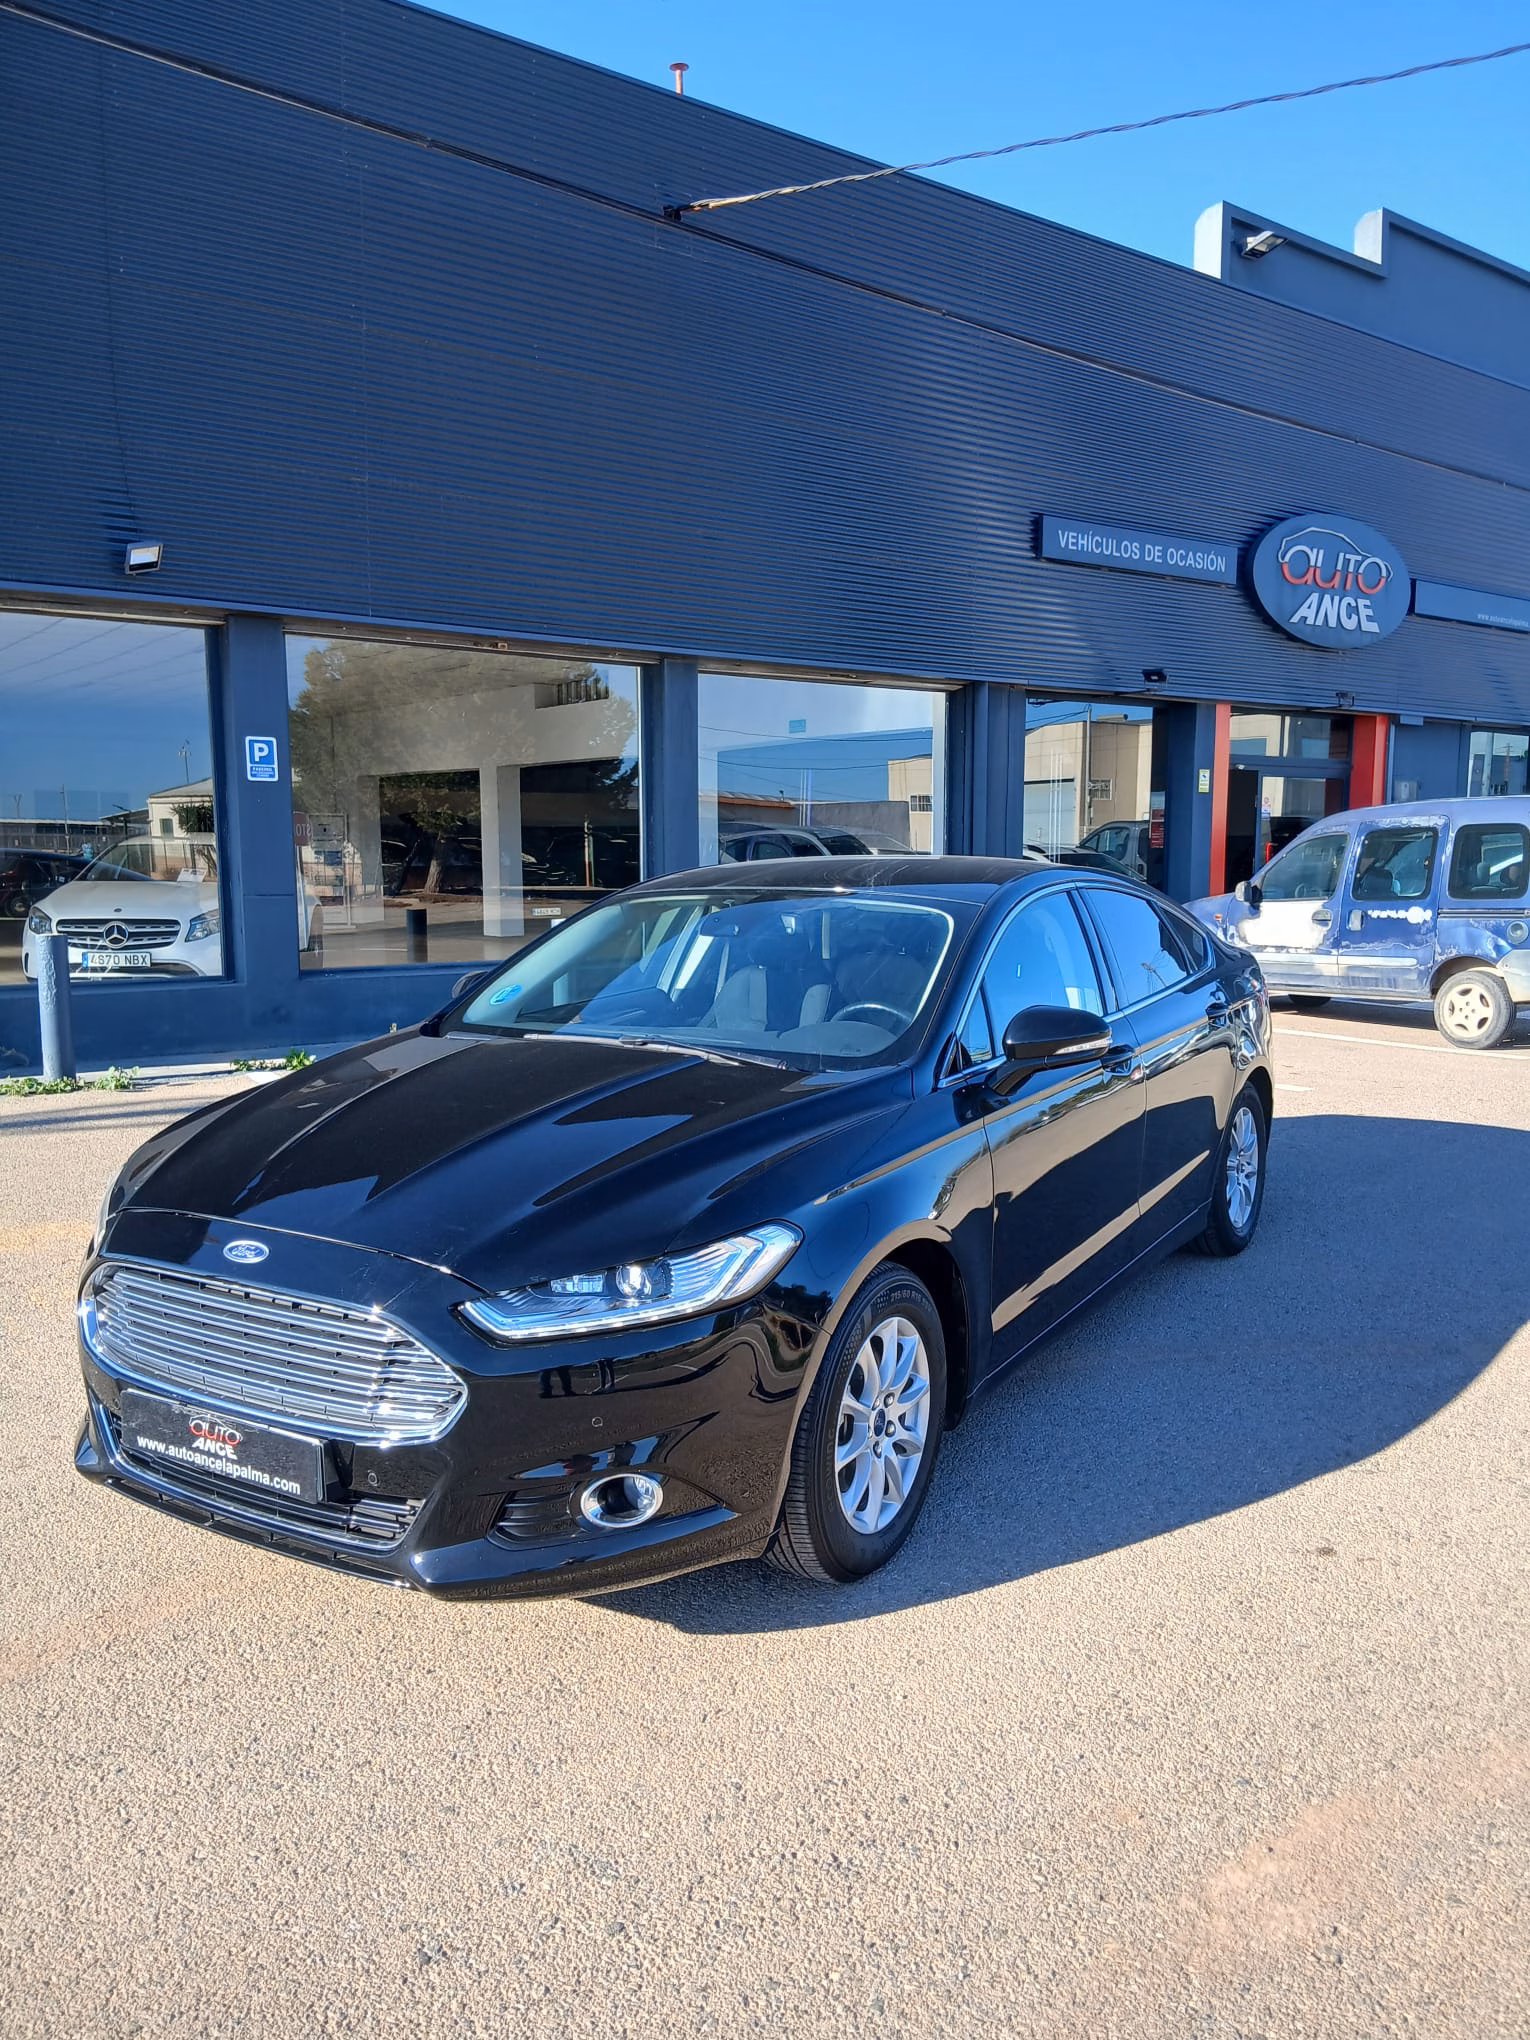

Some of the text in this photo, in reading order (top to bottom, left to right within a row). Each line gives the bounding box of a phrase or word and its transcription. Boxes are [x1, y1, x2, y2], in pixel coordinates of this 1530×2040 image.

[1058, 530, 1226, 573] VEHÍCULOS DE OCASIÓN
[1288, 592, 1380, 633] ANCE
[254, 742, 269, 762] P
[124, 954, 147, 966] NBX
[192, 1437, 238, 1460] ANCE
[136, 1435, 301, 1496] www.autoancelapalma.com
